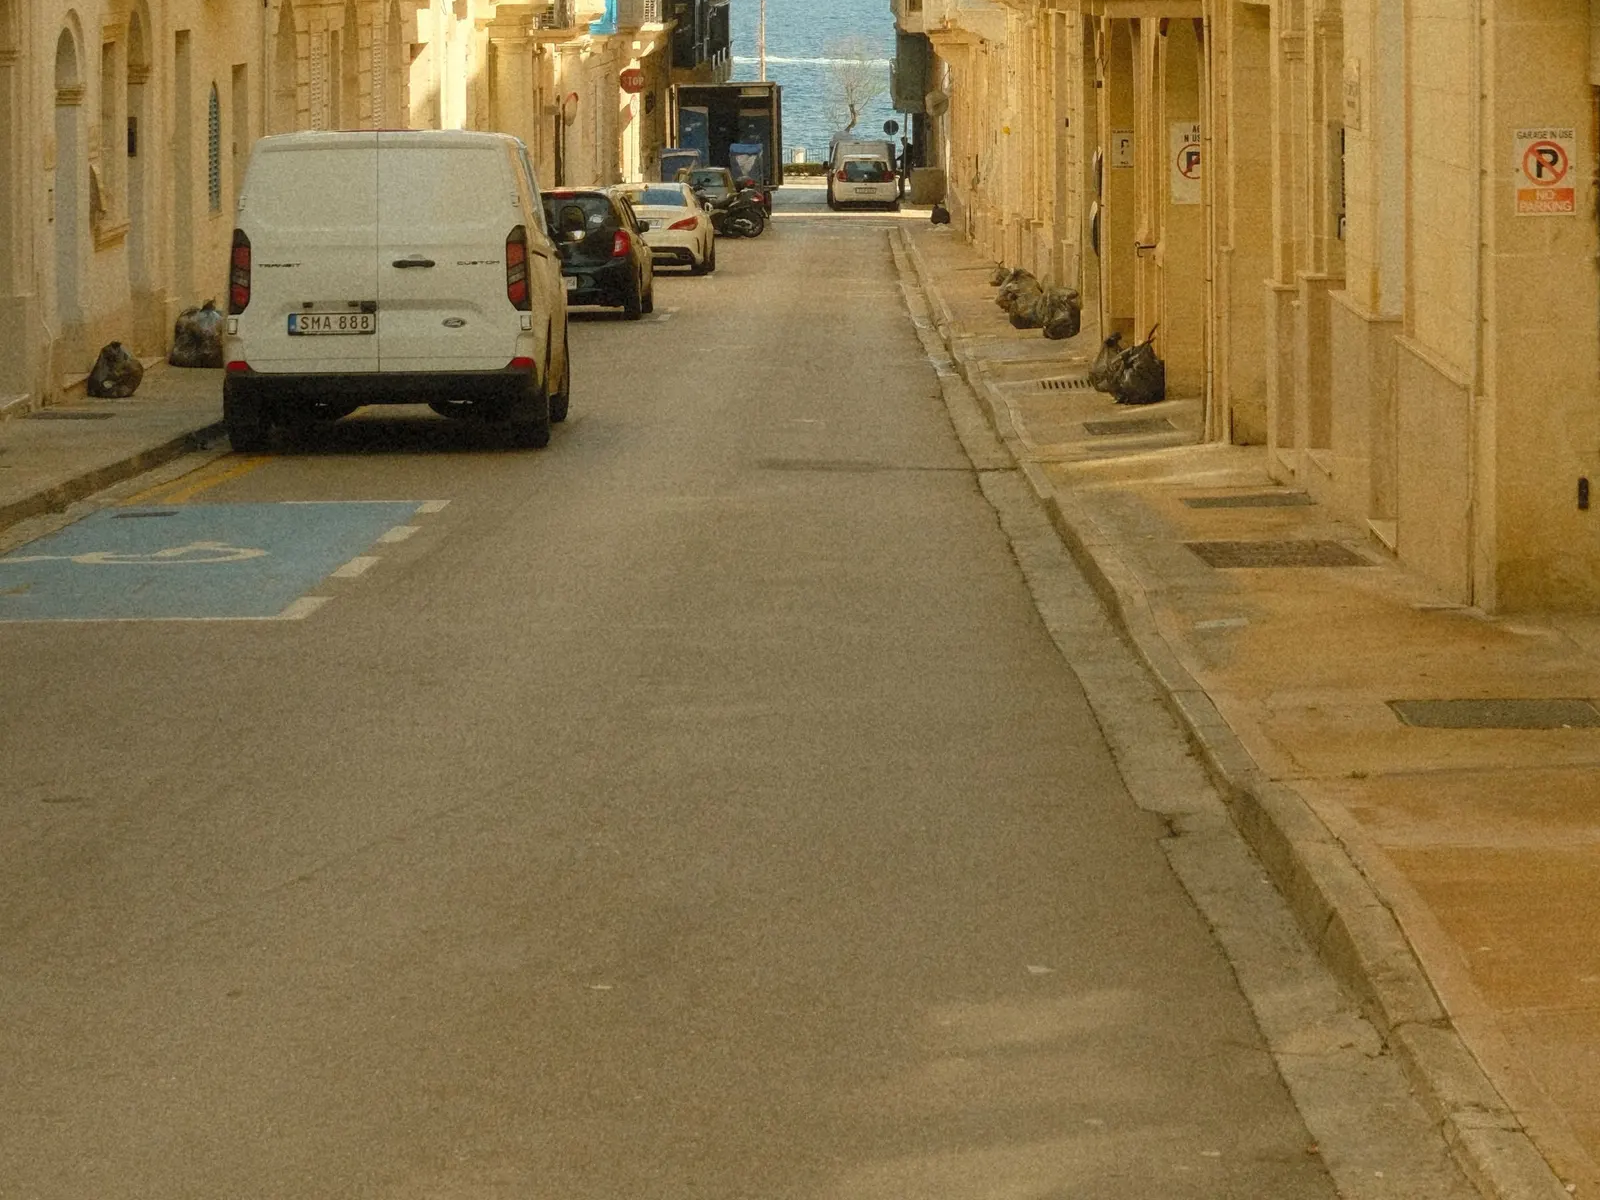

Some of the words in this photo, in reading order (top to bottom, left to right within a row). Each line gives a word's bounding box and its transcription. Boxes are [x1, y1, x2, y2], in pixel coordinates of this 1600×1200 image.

[621, 76, 644, 86] STOP
[1516, 131, 1547, 140] GARAGE
[1550, 131, 1557, 139] IN
[1558, 131, 1573, 139] USE
[1536, 149, 1559, 178] P
[1536, 189, 1555, 200] NO
[1519, 201, 1572, 212] PARKING
[300, 316, 331, 330] SMA
[339, 316, 369, 330] 888
